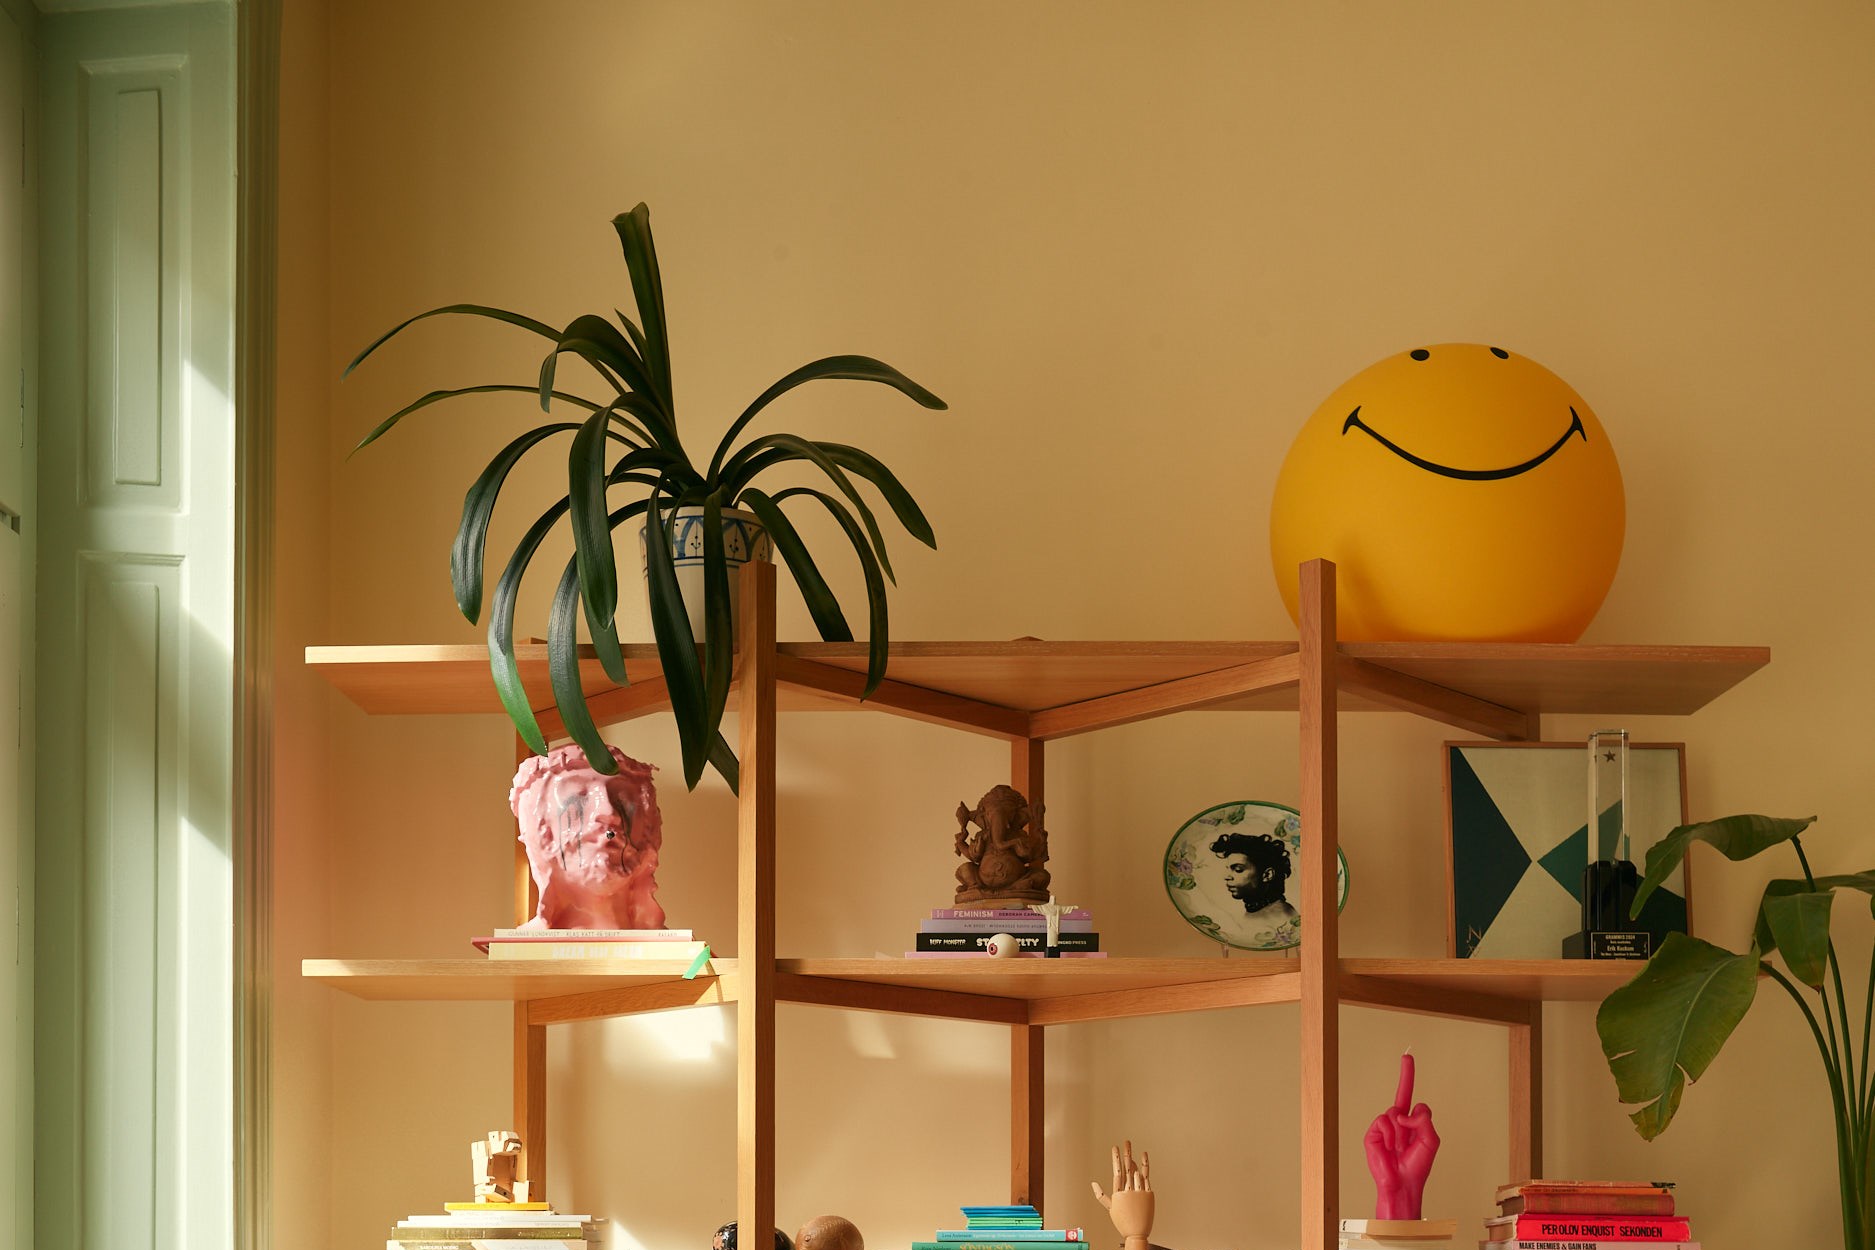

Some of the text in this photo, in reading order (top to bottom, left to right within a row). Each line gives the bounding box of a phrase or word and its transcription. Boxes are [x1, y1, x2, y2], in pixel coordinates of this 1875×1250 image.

[1541, 1224, 1662, 1238] PER OLOV ENQUIST SEKONDEN
[1519, 1242, 1597, 1250] MAKE ENEMIES & GAIN FANS
